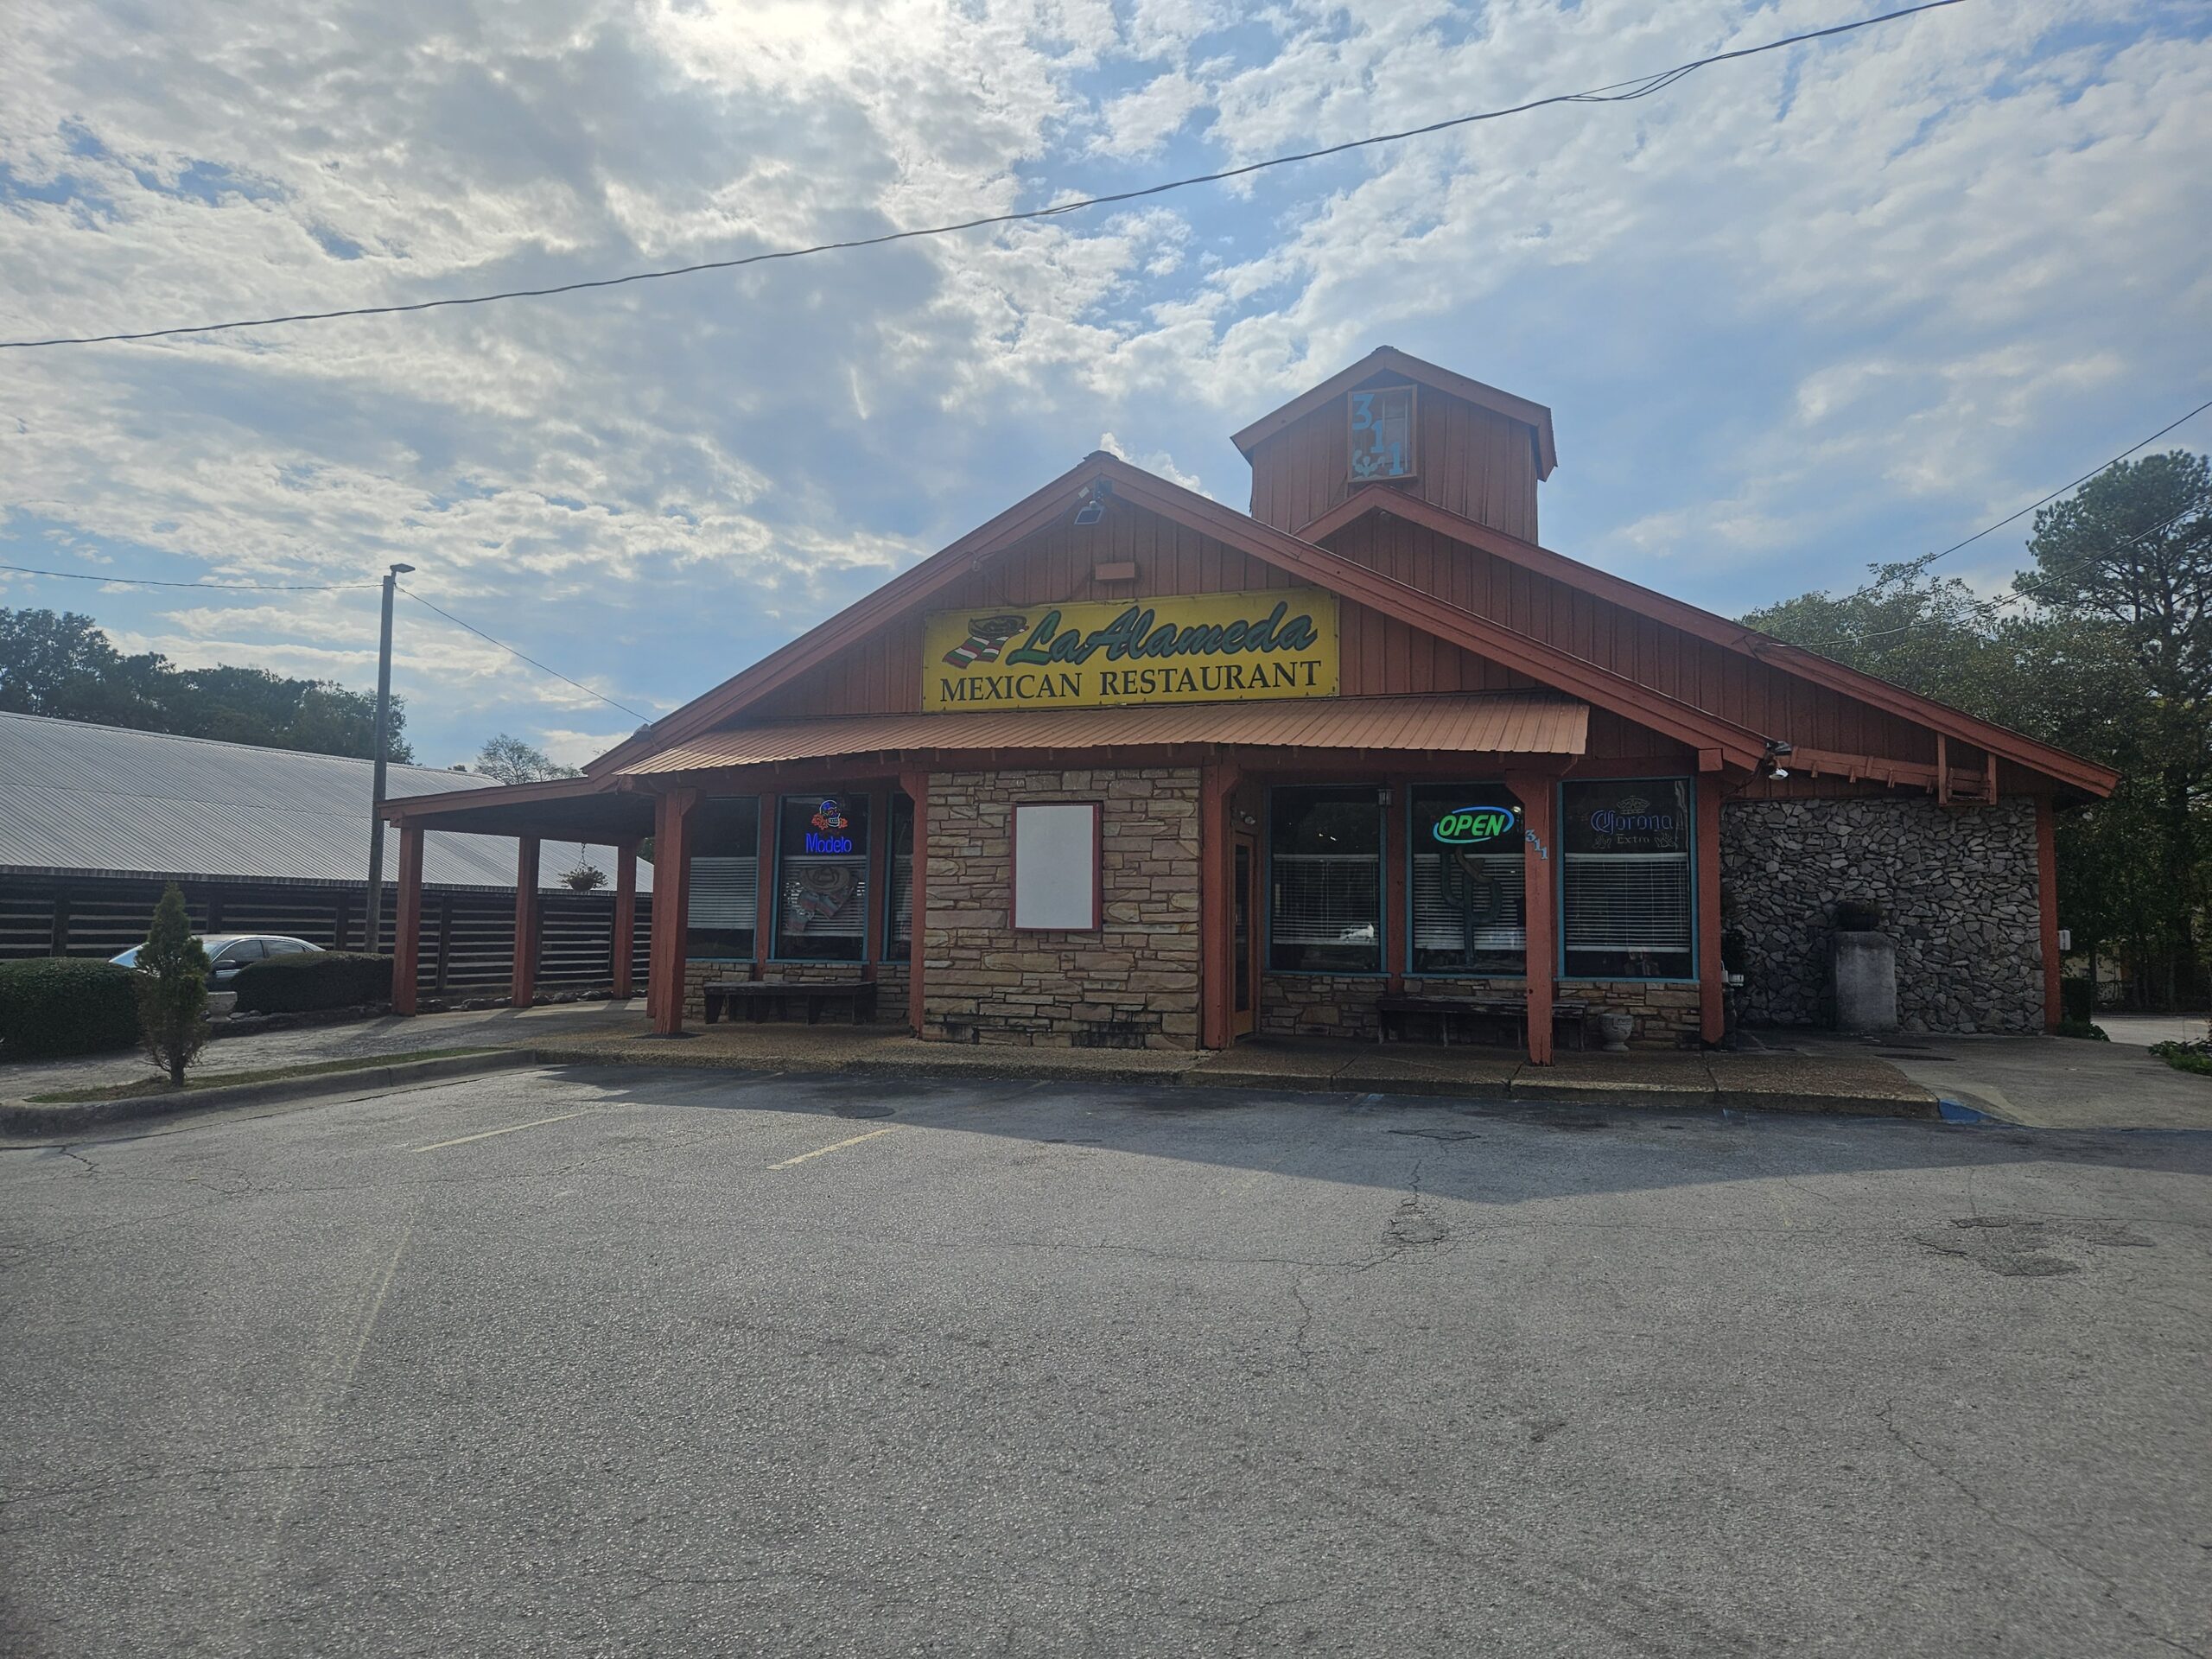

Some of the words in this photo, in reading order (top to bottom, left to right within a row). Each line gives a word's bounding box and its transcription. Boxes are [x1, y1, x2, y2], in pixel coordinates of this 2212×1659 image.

[1005, 610, 1082, 666] La
[1074, 601, 1319, 666] Alameda
[940, 672, 1083, 702] MEXICAN
[1100, 660, 1321, 696] RESTAURANT
[1438, 814, 1505, 836] OPEN
[1591, 810, 1674, 835] Corona
[805, 831, 852, 854] Modelo
[1525, 829, 1548, 860] 311
